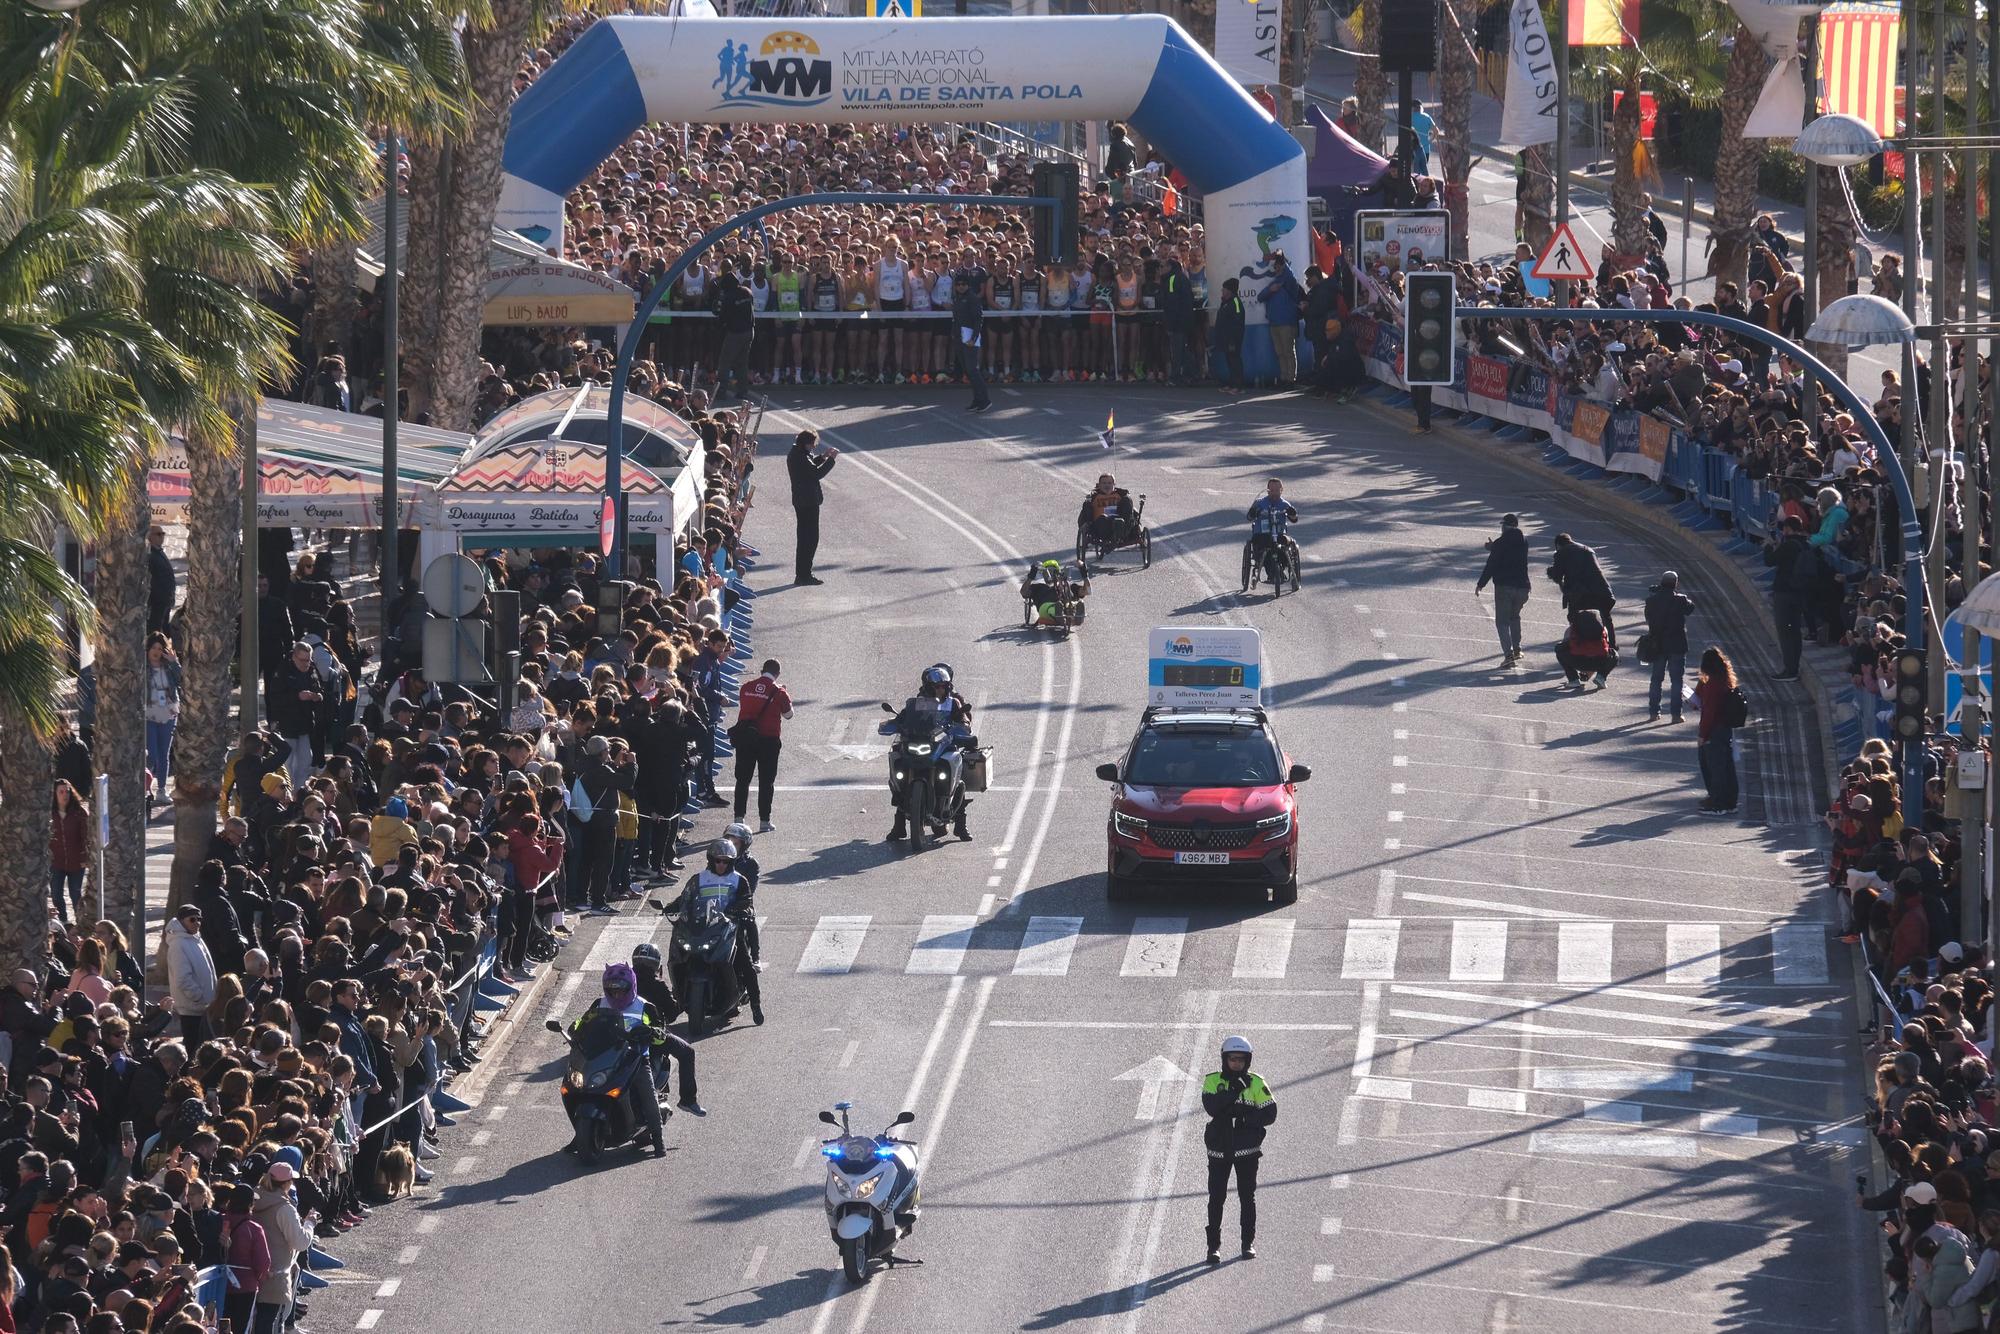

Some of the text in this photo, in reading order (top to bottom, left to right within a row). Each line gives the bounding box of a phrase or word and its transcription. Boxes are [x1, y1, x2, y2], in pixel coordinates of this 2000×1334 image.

[843, 45, 984, 66] MITJA MARATÓ
[842, 67, 995, 86] INTERNACIONAL
[843, 84, 1083, 101] VILA DE SANTA POLA
[841, 101, 984, 111] www.mitjasantapola.com
[544, 267, 563, 276] DE
[567, 270, 615, 292] JIJONA
[507, 305, 532, 322] LUIS
[303, 504, 344, 520] Crepes
[448, 506, 516, 523] Desayunos
[529, 506, 579, 522] Batidos
[1181, 853, 1206, 863] 4962
[1208, 853, 1227, 863] MBZ
